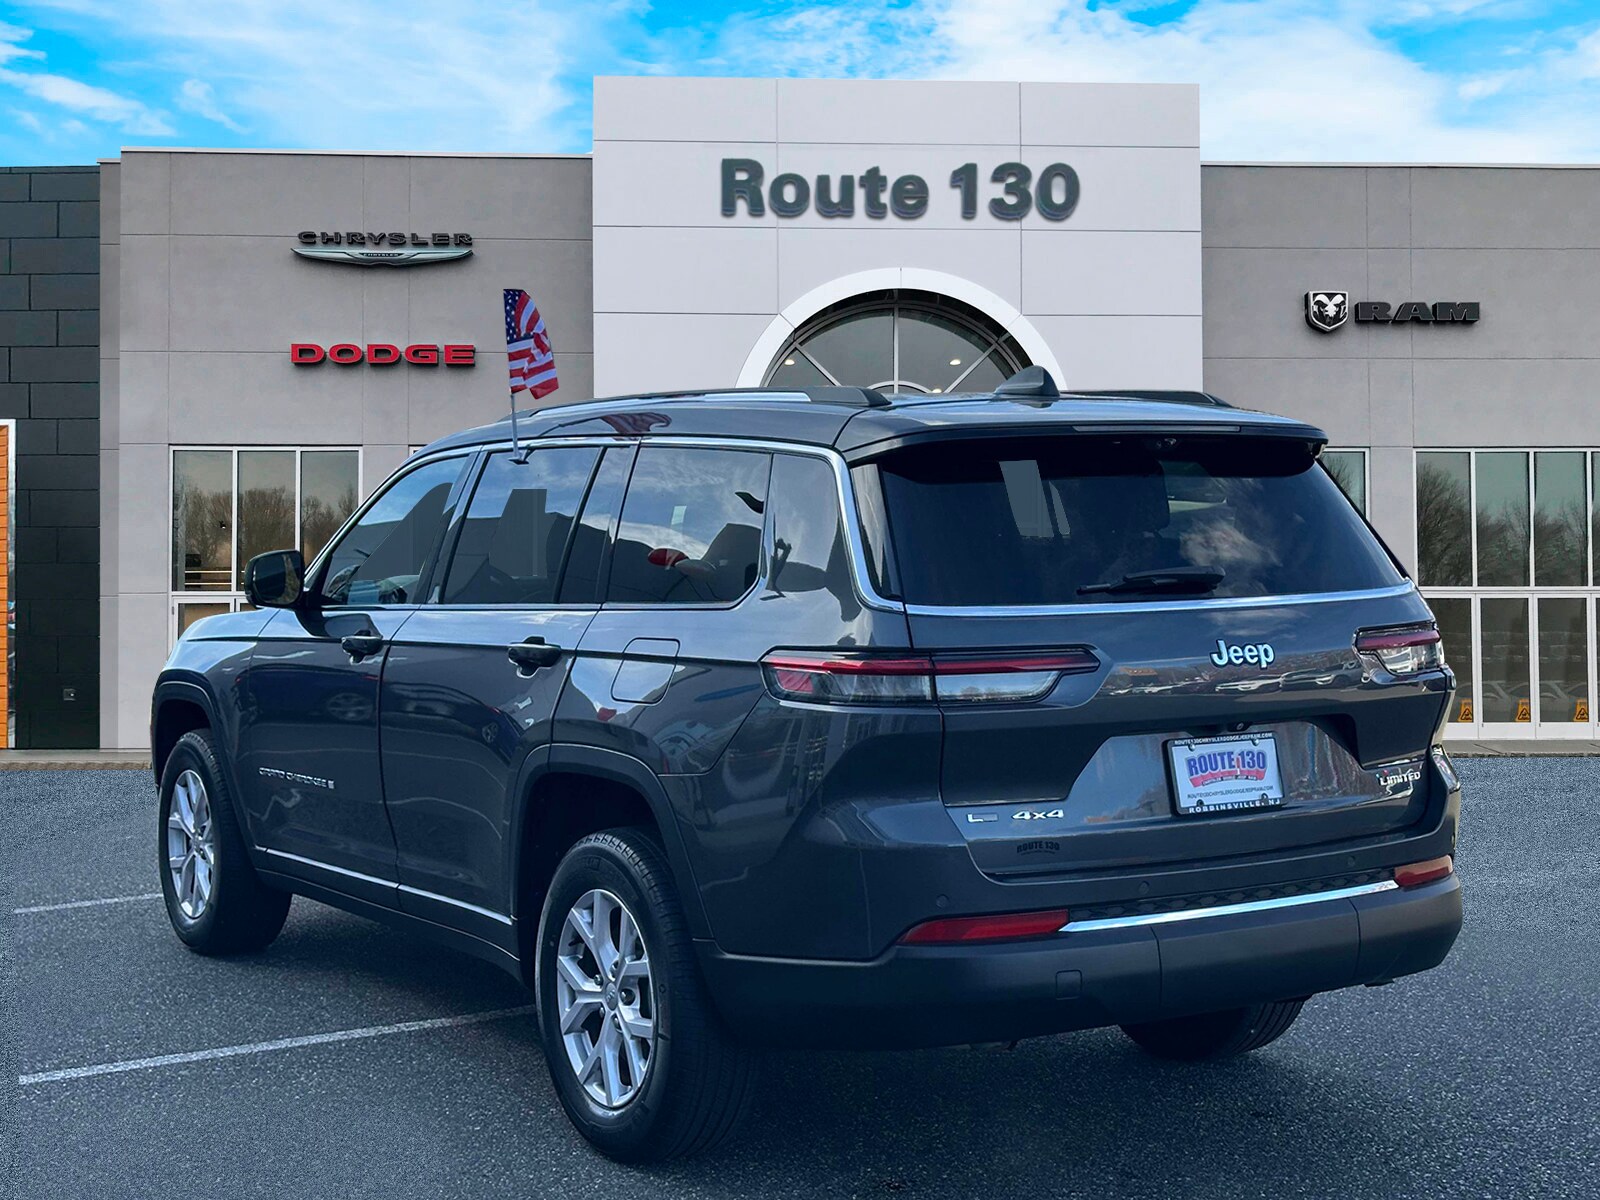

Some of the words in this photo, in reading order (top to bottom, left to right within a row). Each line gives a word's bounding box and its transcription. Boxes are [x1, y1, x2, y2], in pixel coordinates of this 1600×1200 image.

[721, 158, 929, 218] Route
[950, 162, 1081, 221] 130
[298, 231, 473, 245] CHRYSLER
[1354, 301, 1480, 324] RAM
[291, 343, 476, 366] DODGE
[1210, 639, 1275, 670] Jeep
[1186, 751, 1235, 777] ROUTE
[1238, 750, 1267, 769] 130
[1012, 809, 1065, 820] 4x4
[1017, 841, 1044, 853] ROUTE
[1045, 841, 1060, 851] 130
